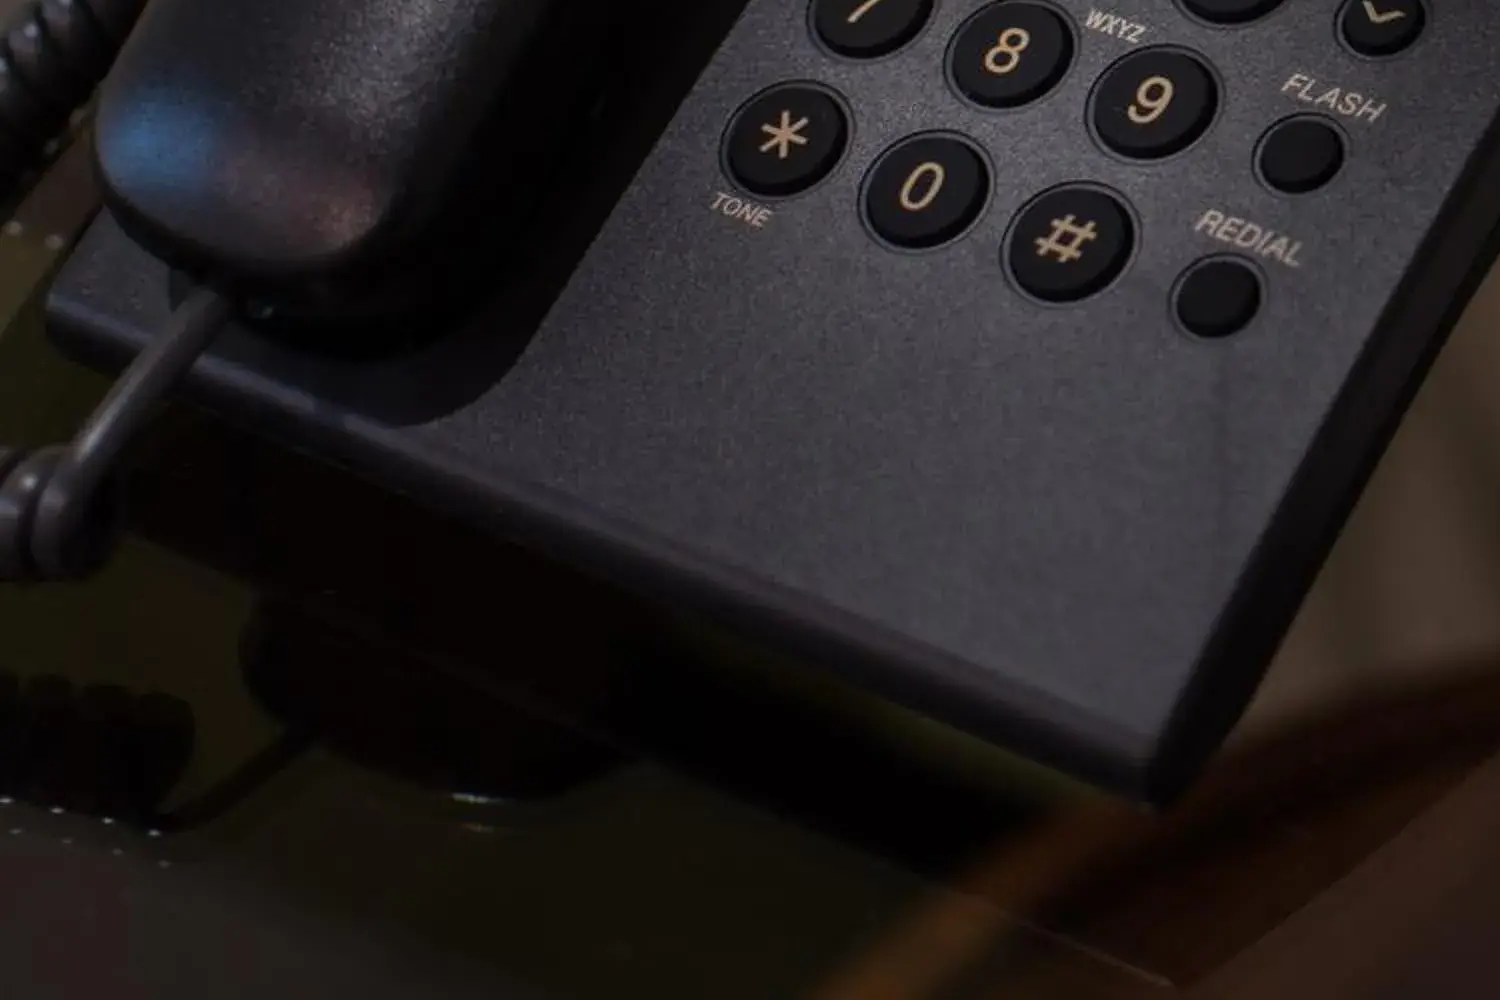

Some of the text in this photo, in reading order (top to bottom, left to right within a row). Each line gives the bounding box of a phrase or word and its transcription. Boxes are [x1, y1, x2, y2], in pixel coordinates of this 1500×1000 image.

[983, 26, 1031, 75] 8
[1084, 6, 1150, 45] WXYZ
[1126, 74, 1174, 125] 9
[1280, 71, 1388, 124] FLASH
[710, 190, 773, 229] TONE
[899, 161, 945, 212] 0
[1193, 208, 1304, 268] REDIAL
